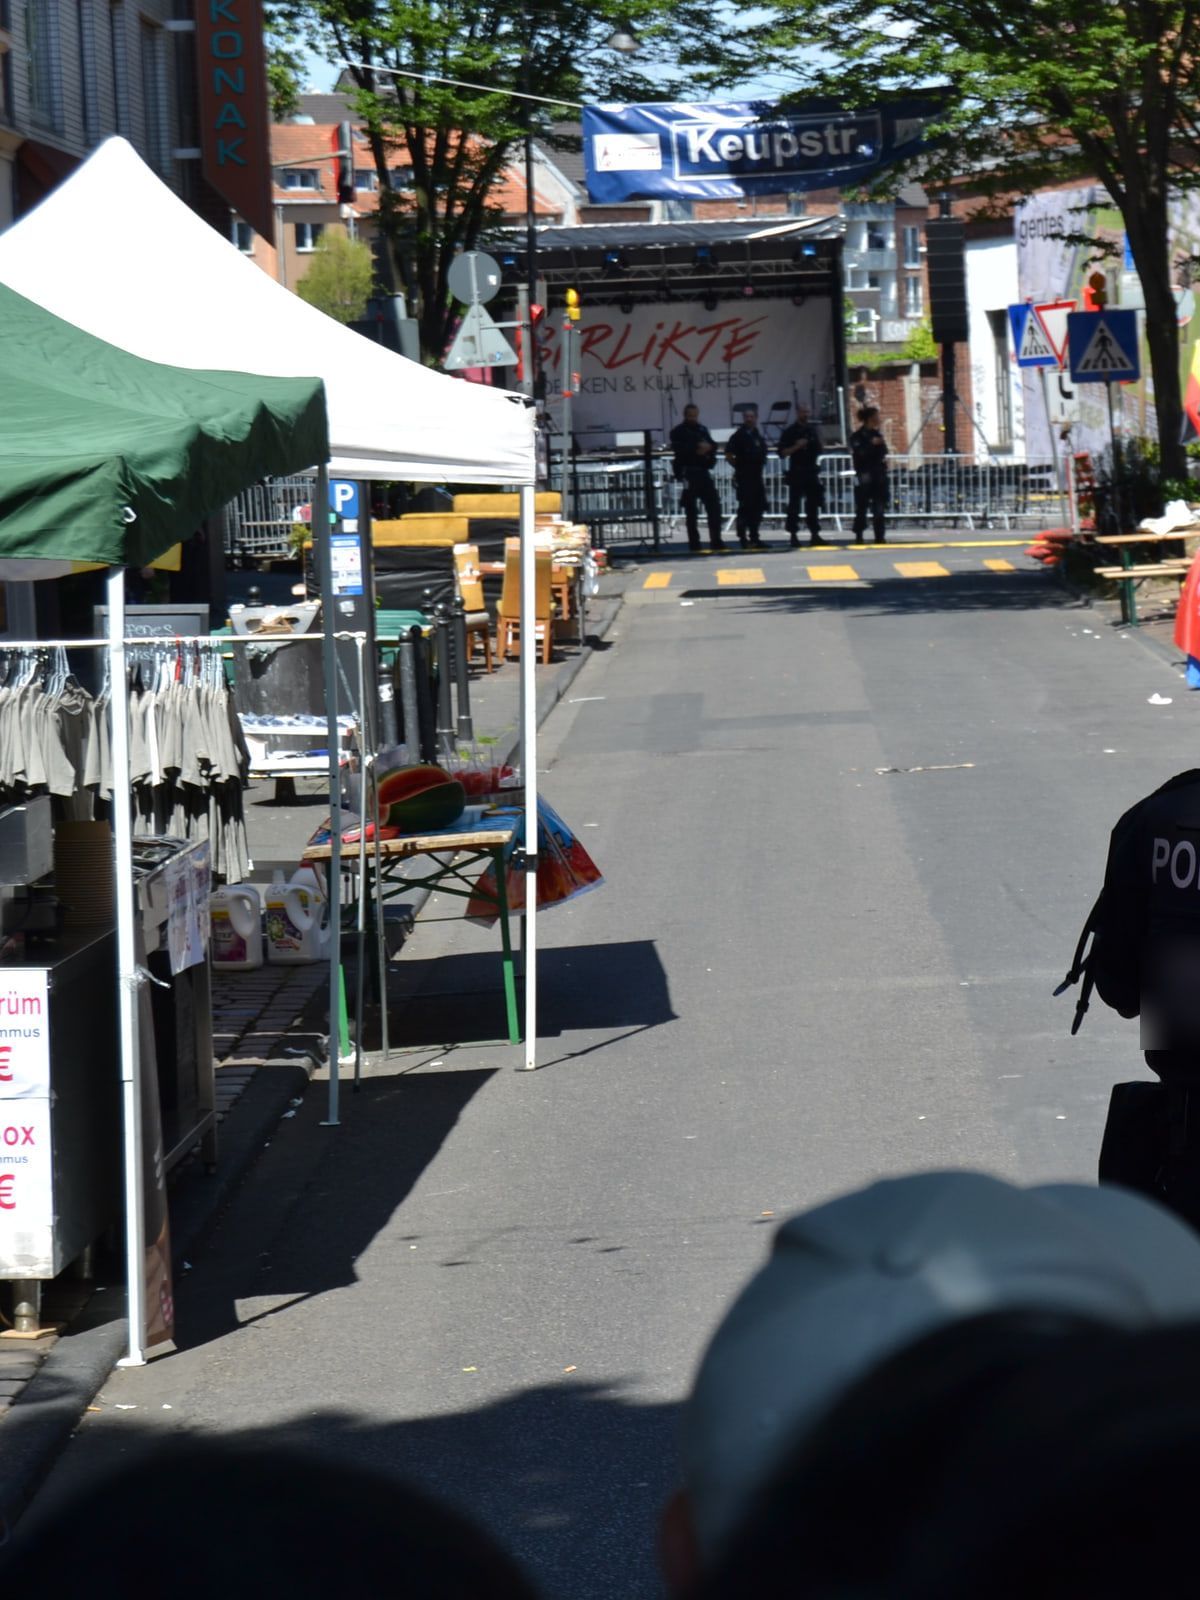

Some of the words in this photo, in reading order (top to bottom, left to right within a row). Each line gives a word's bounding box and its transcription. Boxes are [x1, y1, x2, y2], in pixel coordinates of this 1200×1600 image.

[209, 0, 248, 167] KONAK
[623, 375, 639, 394] &
[643, 368, 764, 394] KULTURFEST
[334, 483, 354, 512] P
[0, 1127, 35, 1145] ox
